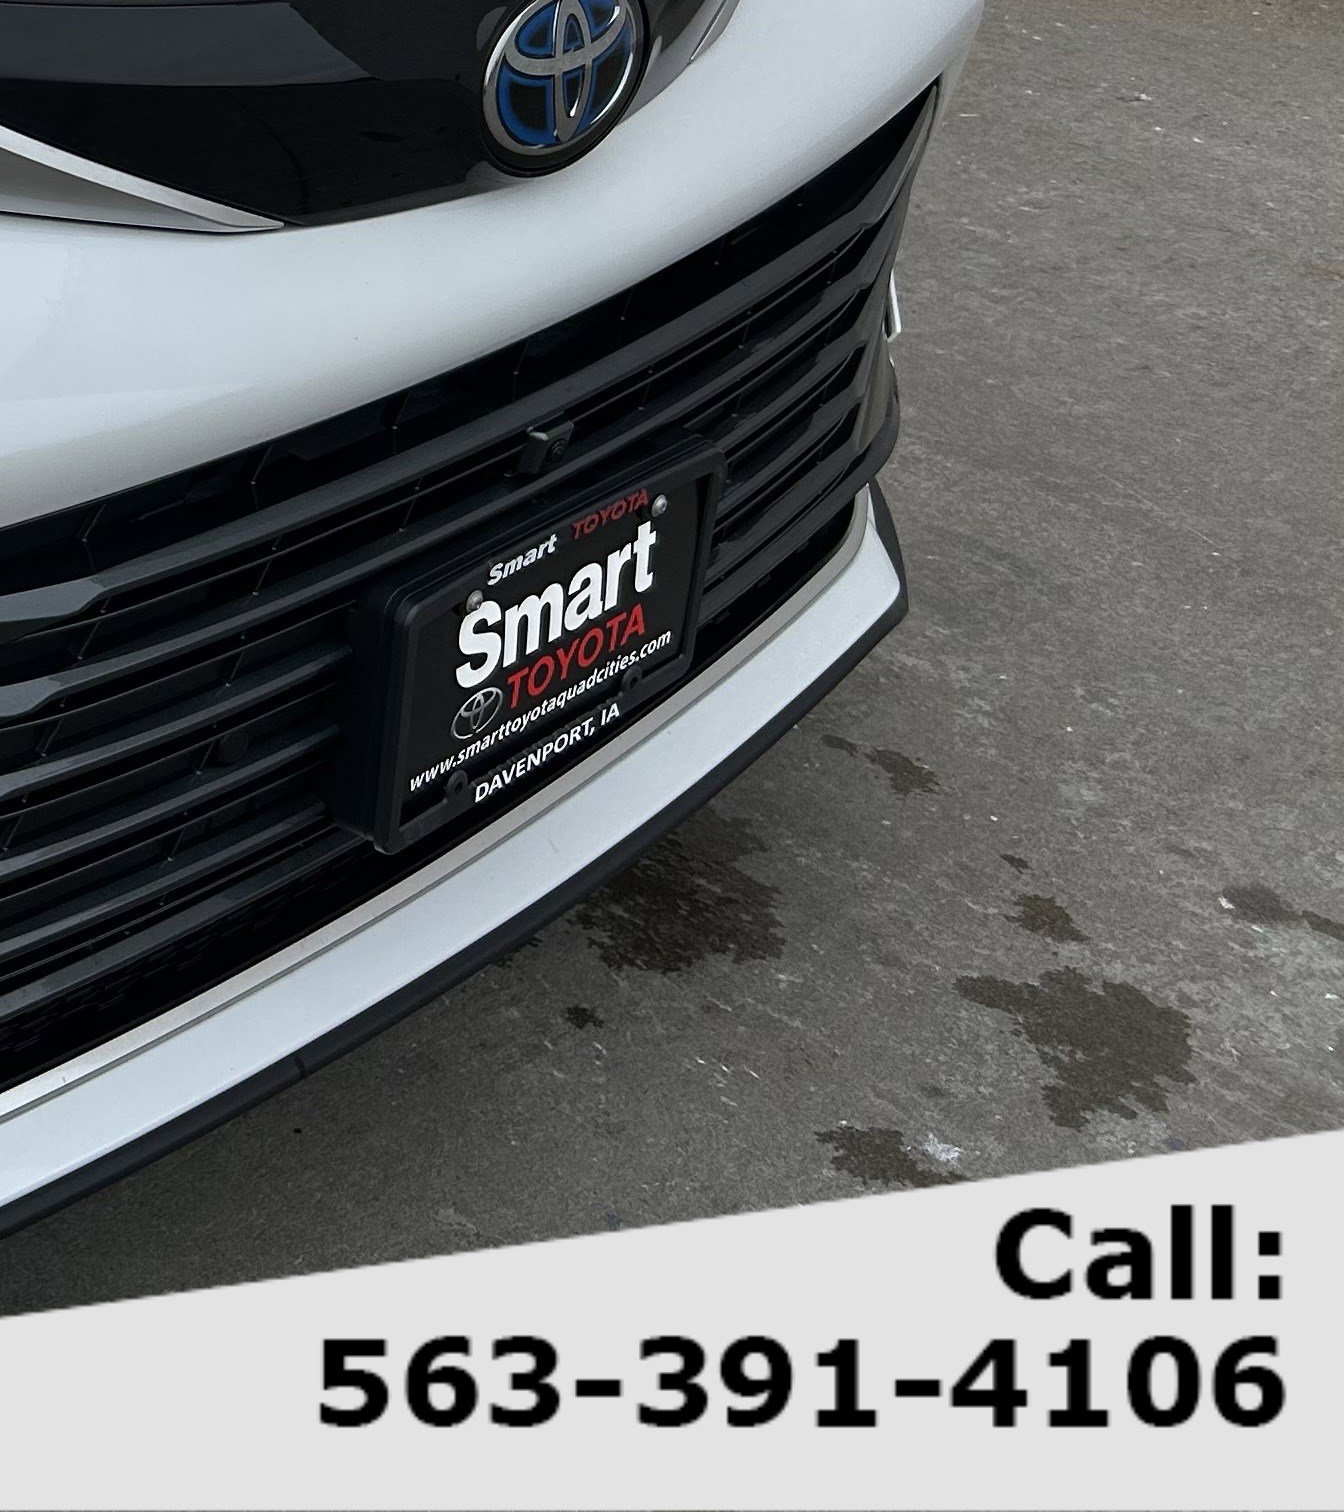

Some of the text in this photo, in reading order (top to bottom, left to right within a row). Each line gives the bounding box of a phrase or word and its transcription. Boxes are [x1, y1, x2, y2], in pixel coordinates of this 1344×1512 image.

[486, 489, 650, 586] Smart TOYOTA
[455, 520, 657, 689] Smart
[507, 604, 646, 709] TOYOTA
[410, 629, 672, 792] www.smarttoyotaquadcities.com
[475, 702, 621, 803] DAVENPORT, IA
